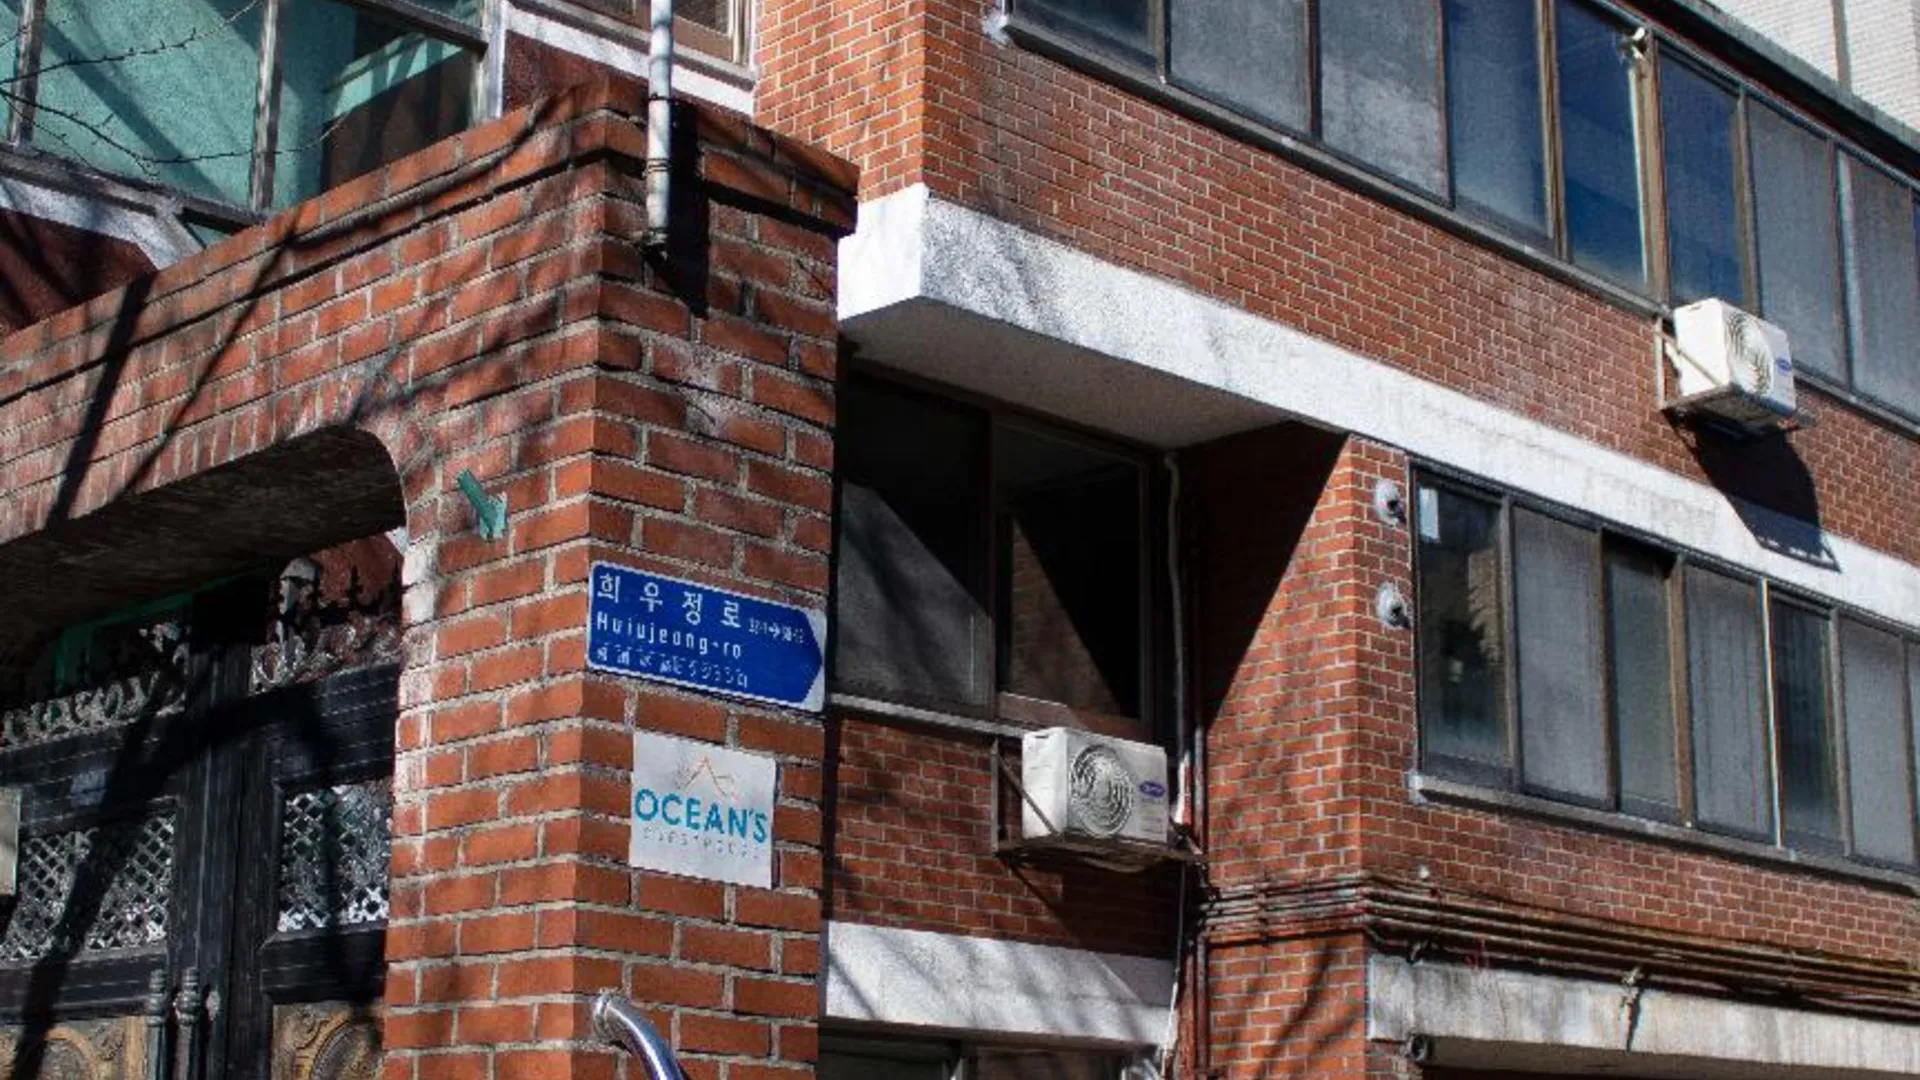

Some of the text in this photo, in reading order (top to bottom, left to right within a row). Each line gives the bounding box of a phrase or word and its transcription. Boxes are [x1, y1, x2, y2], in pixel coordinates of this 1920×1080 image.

[597, 573, 741, 628] 희우정로
[596, 611, 741, 658] Huiujeong-ro
[634, 788, 768, 844] OCEAN'S
